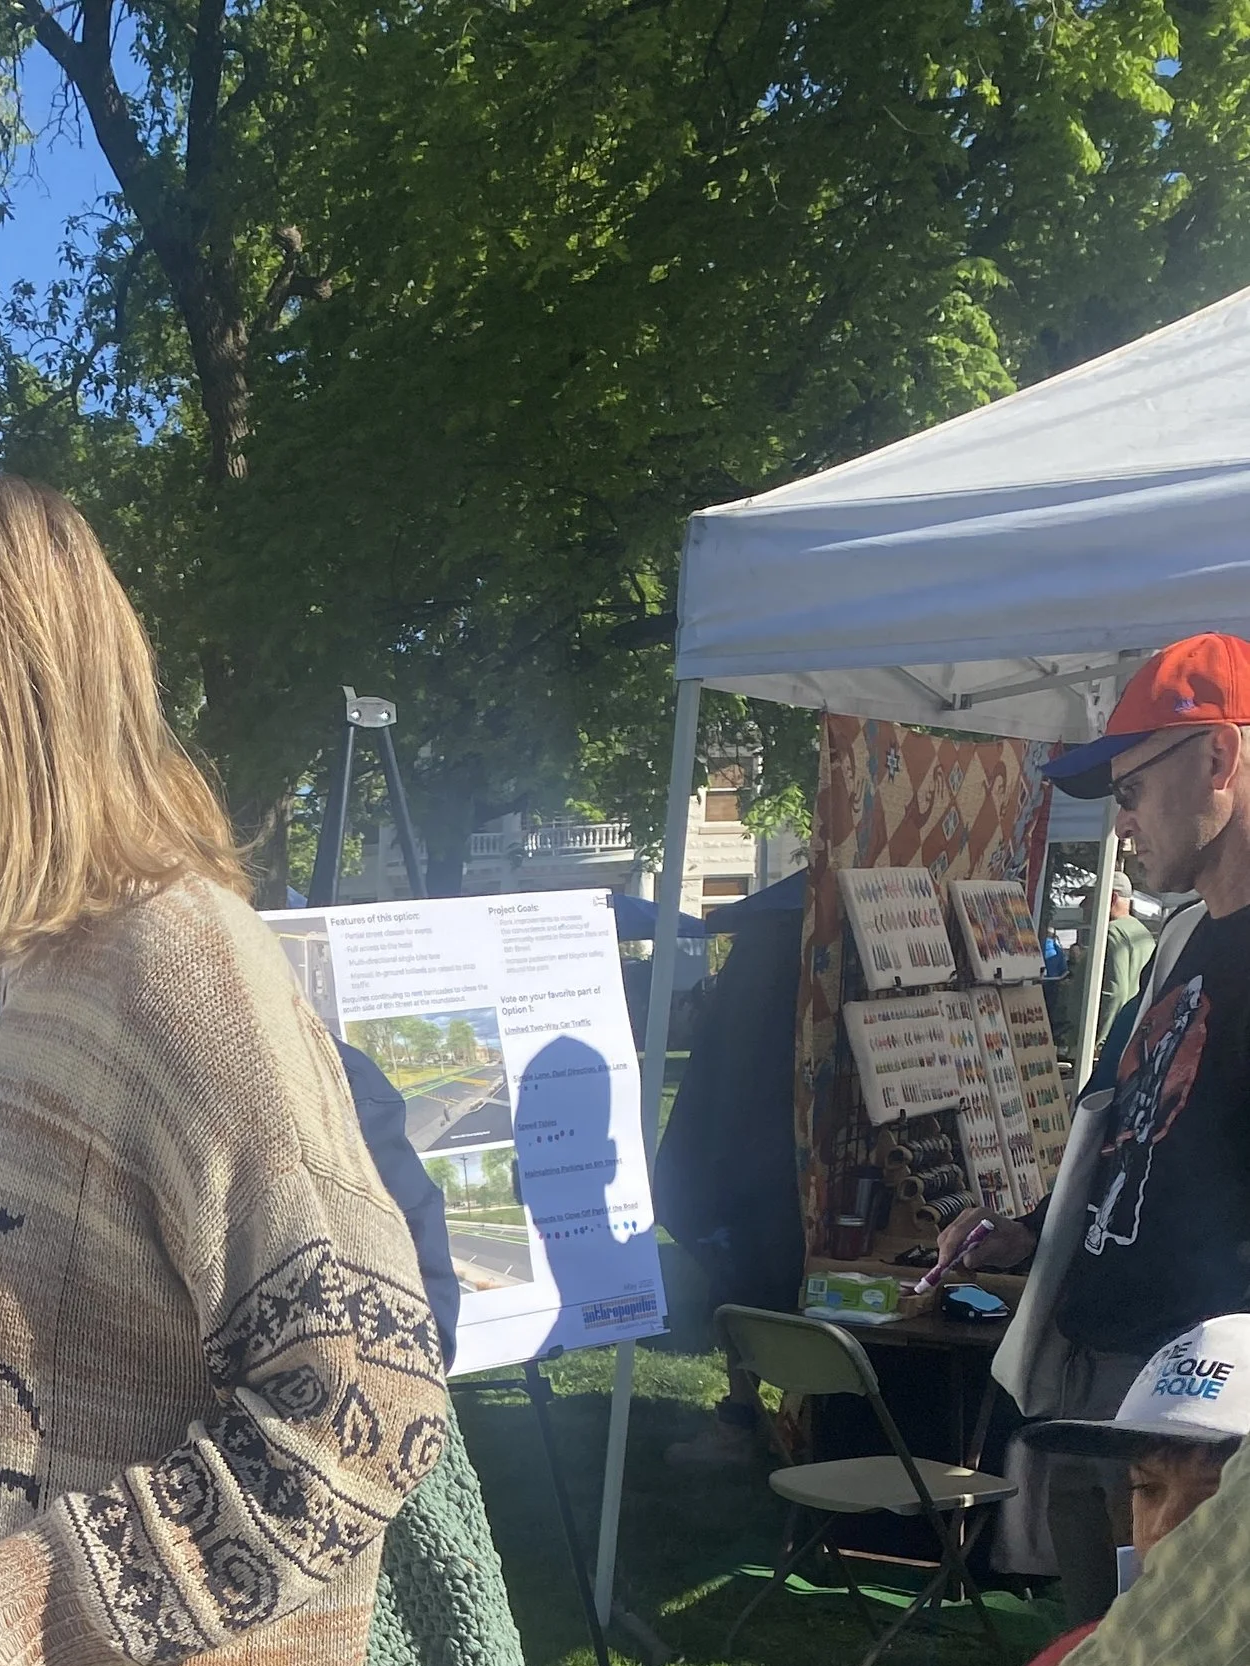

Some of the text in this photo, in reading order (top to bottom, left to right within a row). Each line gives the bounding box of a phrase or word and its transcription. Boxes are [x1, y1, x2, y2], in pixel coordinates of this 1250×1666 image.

[488, 904, 539, 916] Project Goals:
[330, 913, 420, 927] Features of this option:
[500, 996, 518, 1004] Vote
[529, 994, 546, 1002] your
[548, 989, 576, 1000] favorite
[578, 987, 592, 997] part
[593, 986, 601, 994] of
[502, 1006, 527, 1016] Option
[505, 1024, 529, 1035] Limited
[530, 1022, 559, 1031] Two-Way
